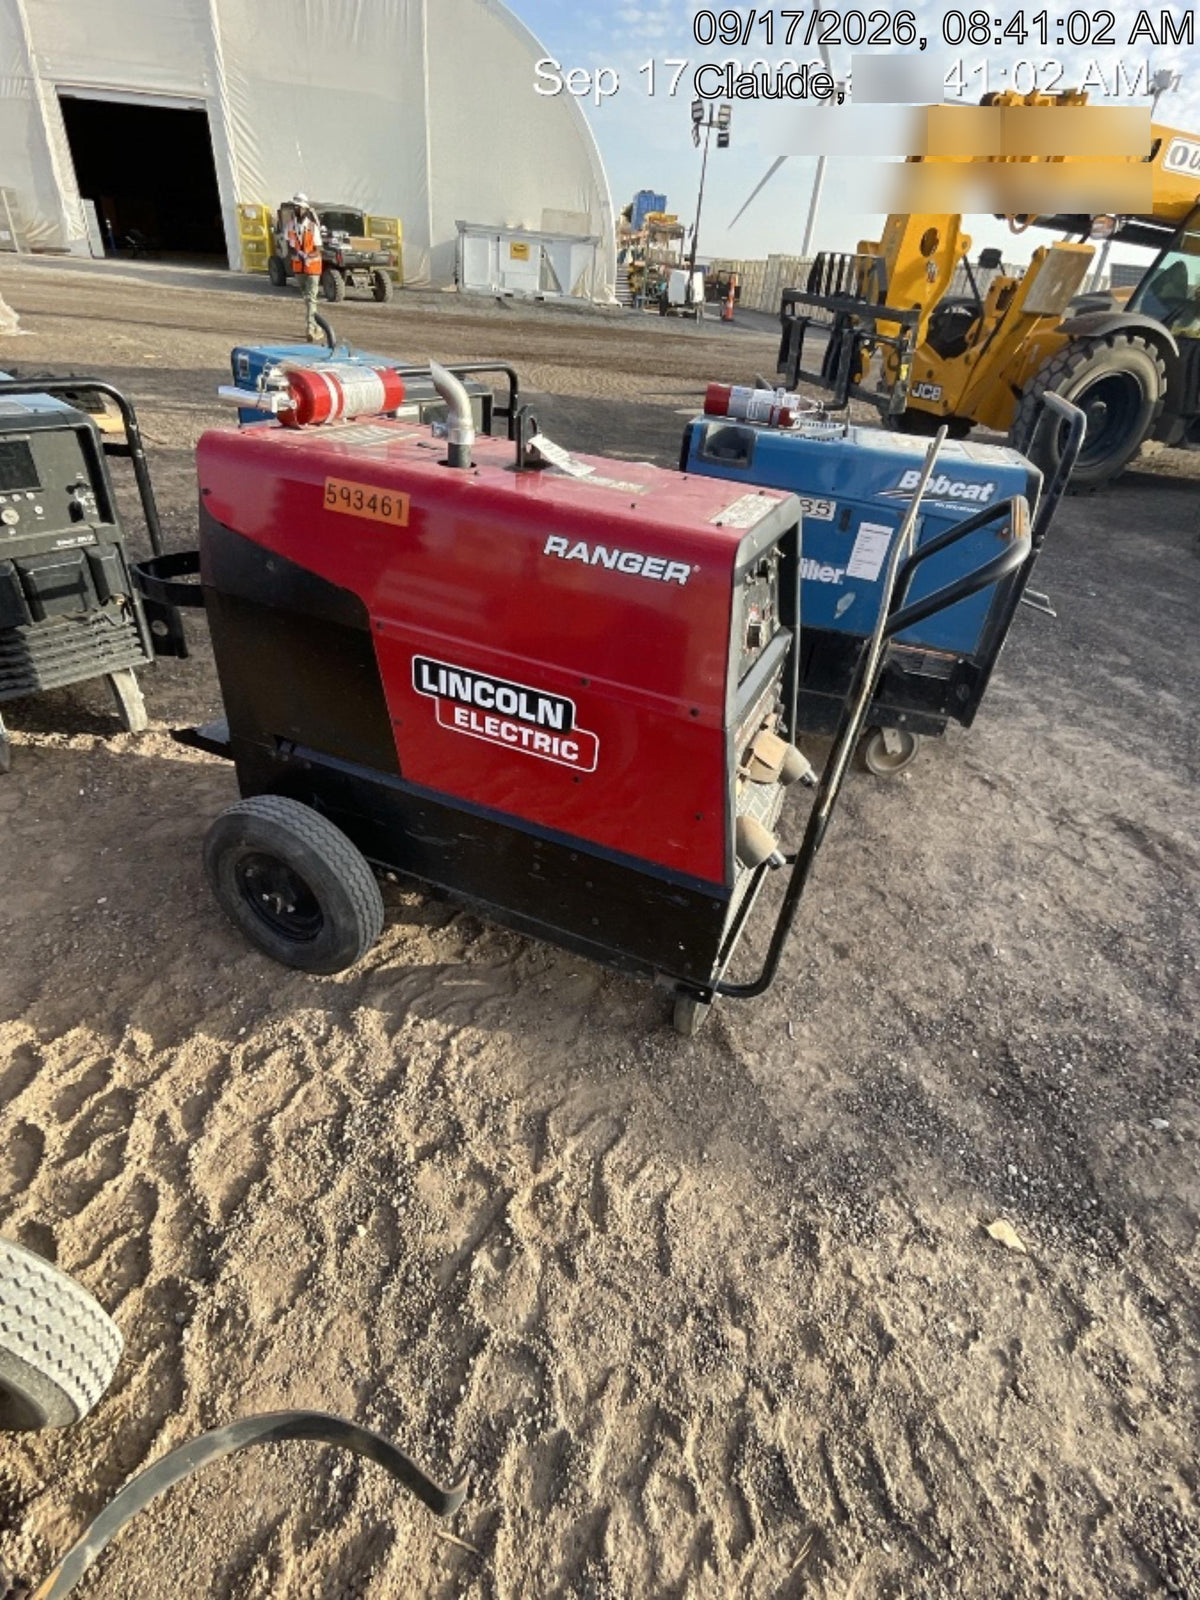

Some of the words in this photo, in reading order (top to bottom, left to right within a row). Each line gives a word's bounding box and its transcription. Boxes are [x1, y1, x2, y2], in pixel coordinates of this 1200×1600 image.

[911, 383, 942, 401] JCB
[326, 482, 403, 520] 593461
[543, 534, 692, 586] RANGER
[800, 557, 844, 584] iller
[421, 664, 564, 730] LINCOLN
[454, 706, 579, 761] ELECTRIC
